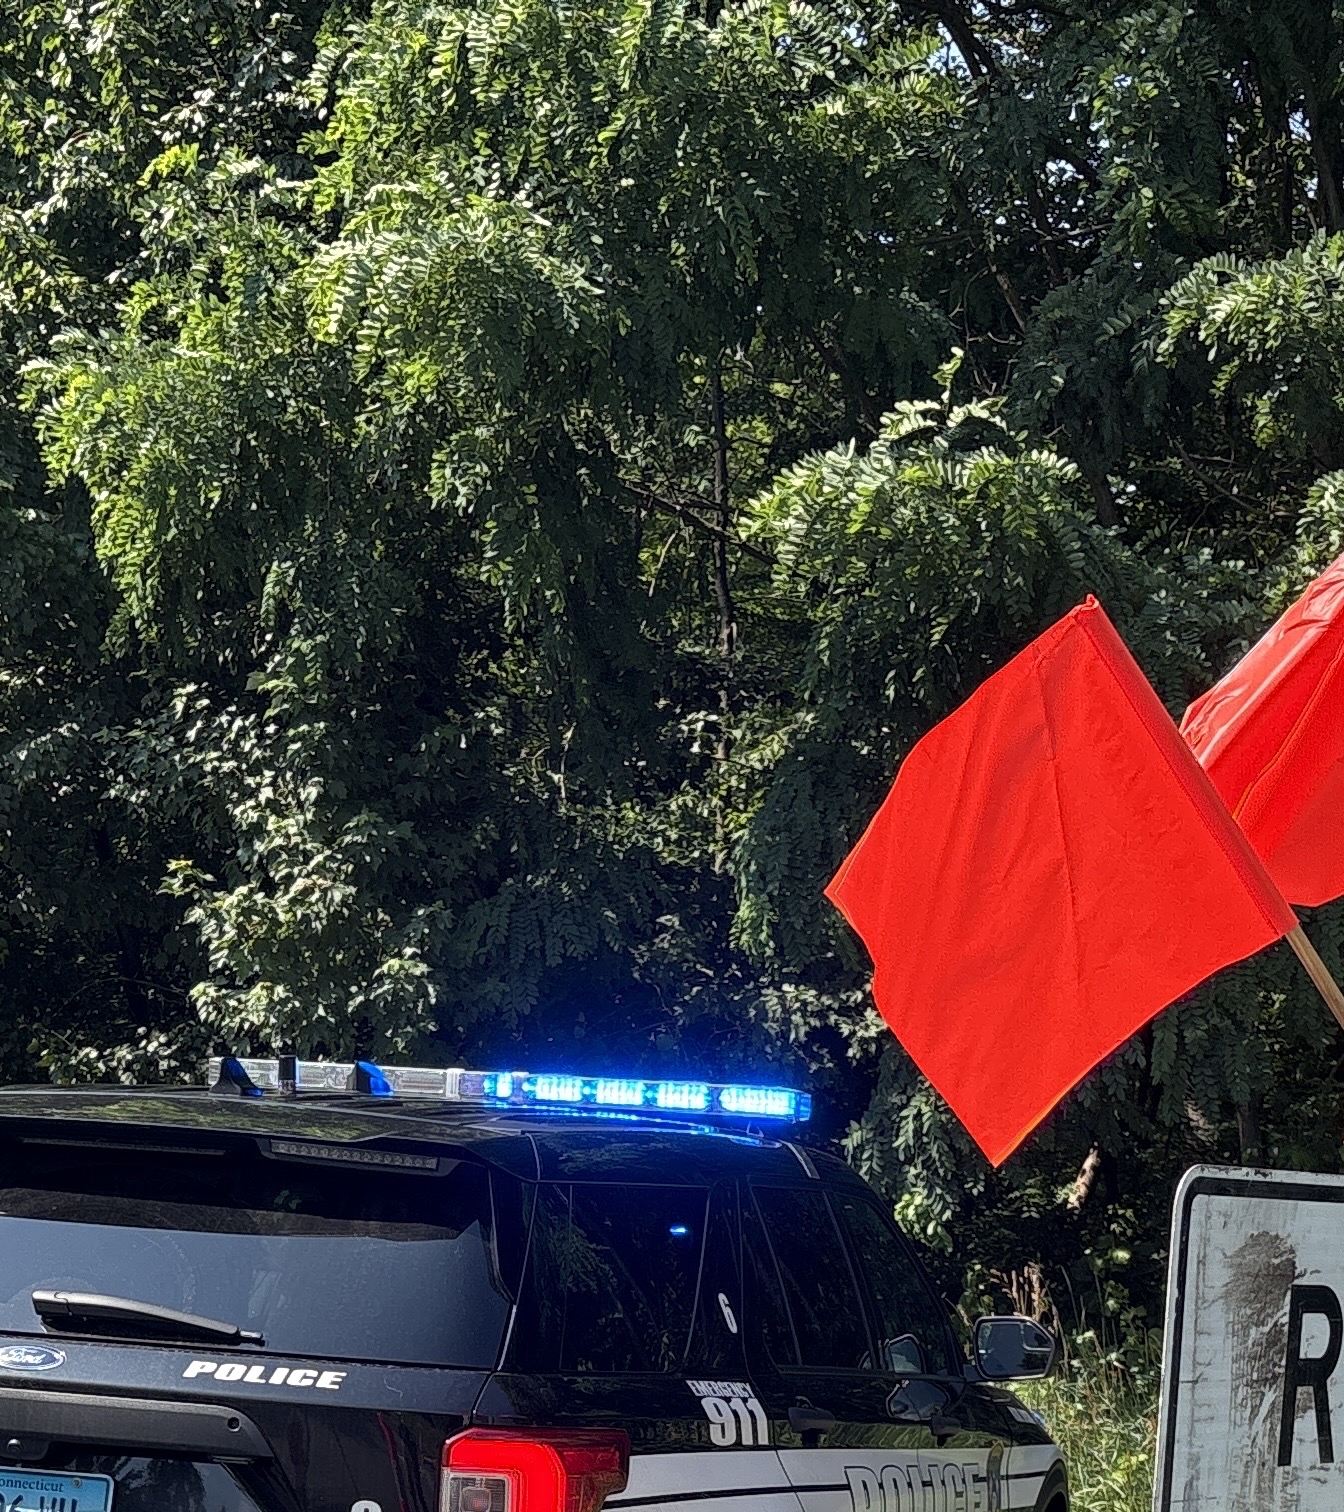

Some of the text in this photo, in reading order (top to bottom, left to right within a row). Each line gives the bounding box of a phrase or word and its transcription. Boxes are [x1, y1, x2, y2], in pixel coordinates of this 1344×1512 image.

[717, 1292, 738, 1334] 6
[182, 1359, 348, 1391] POLICE
[685, 1379, 756, 1398] EMERGENCY
[700, 1396, 770, 1447] 911
